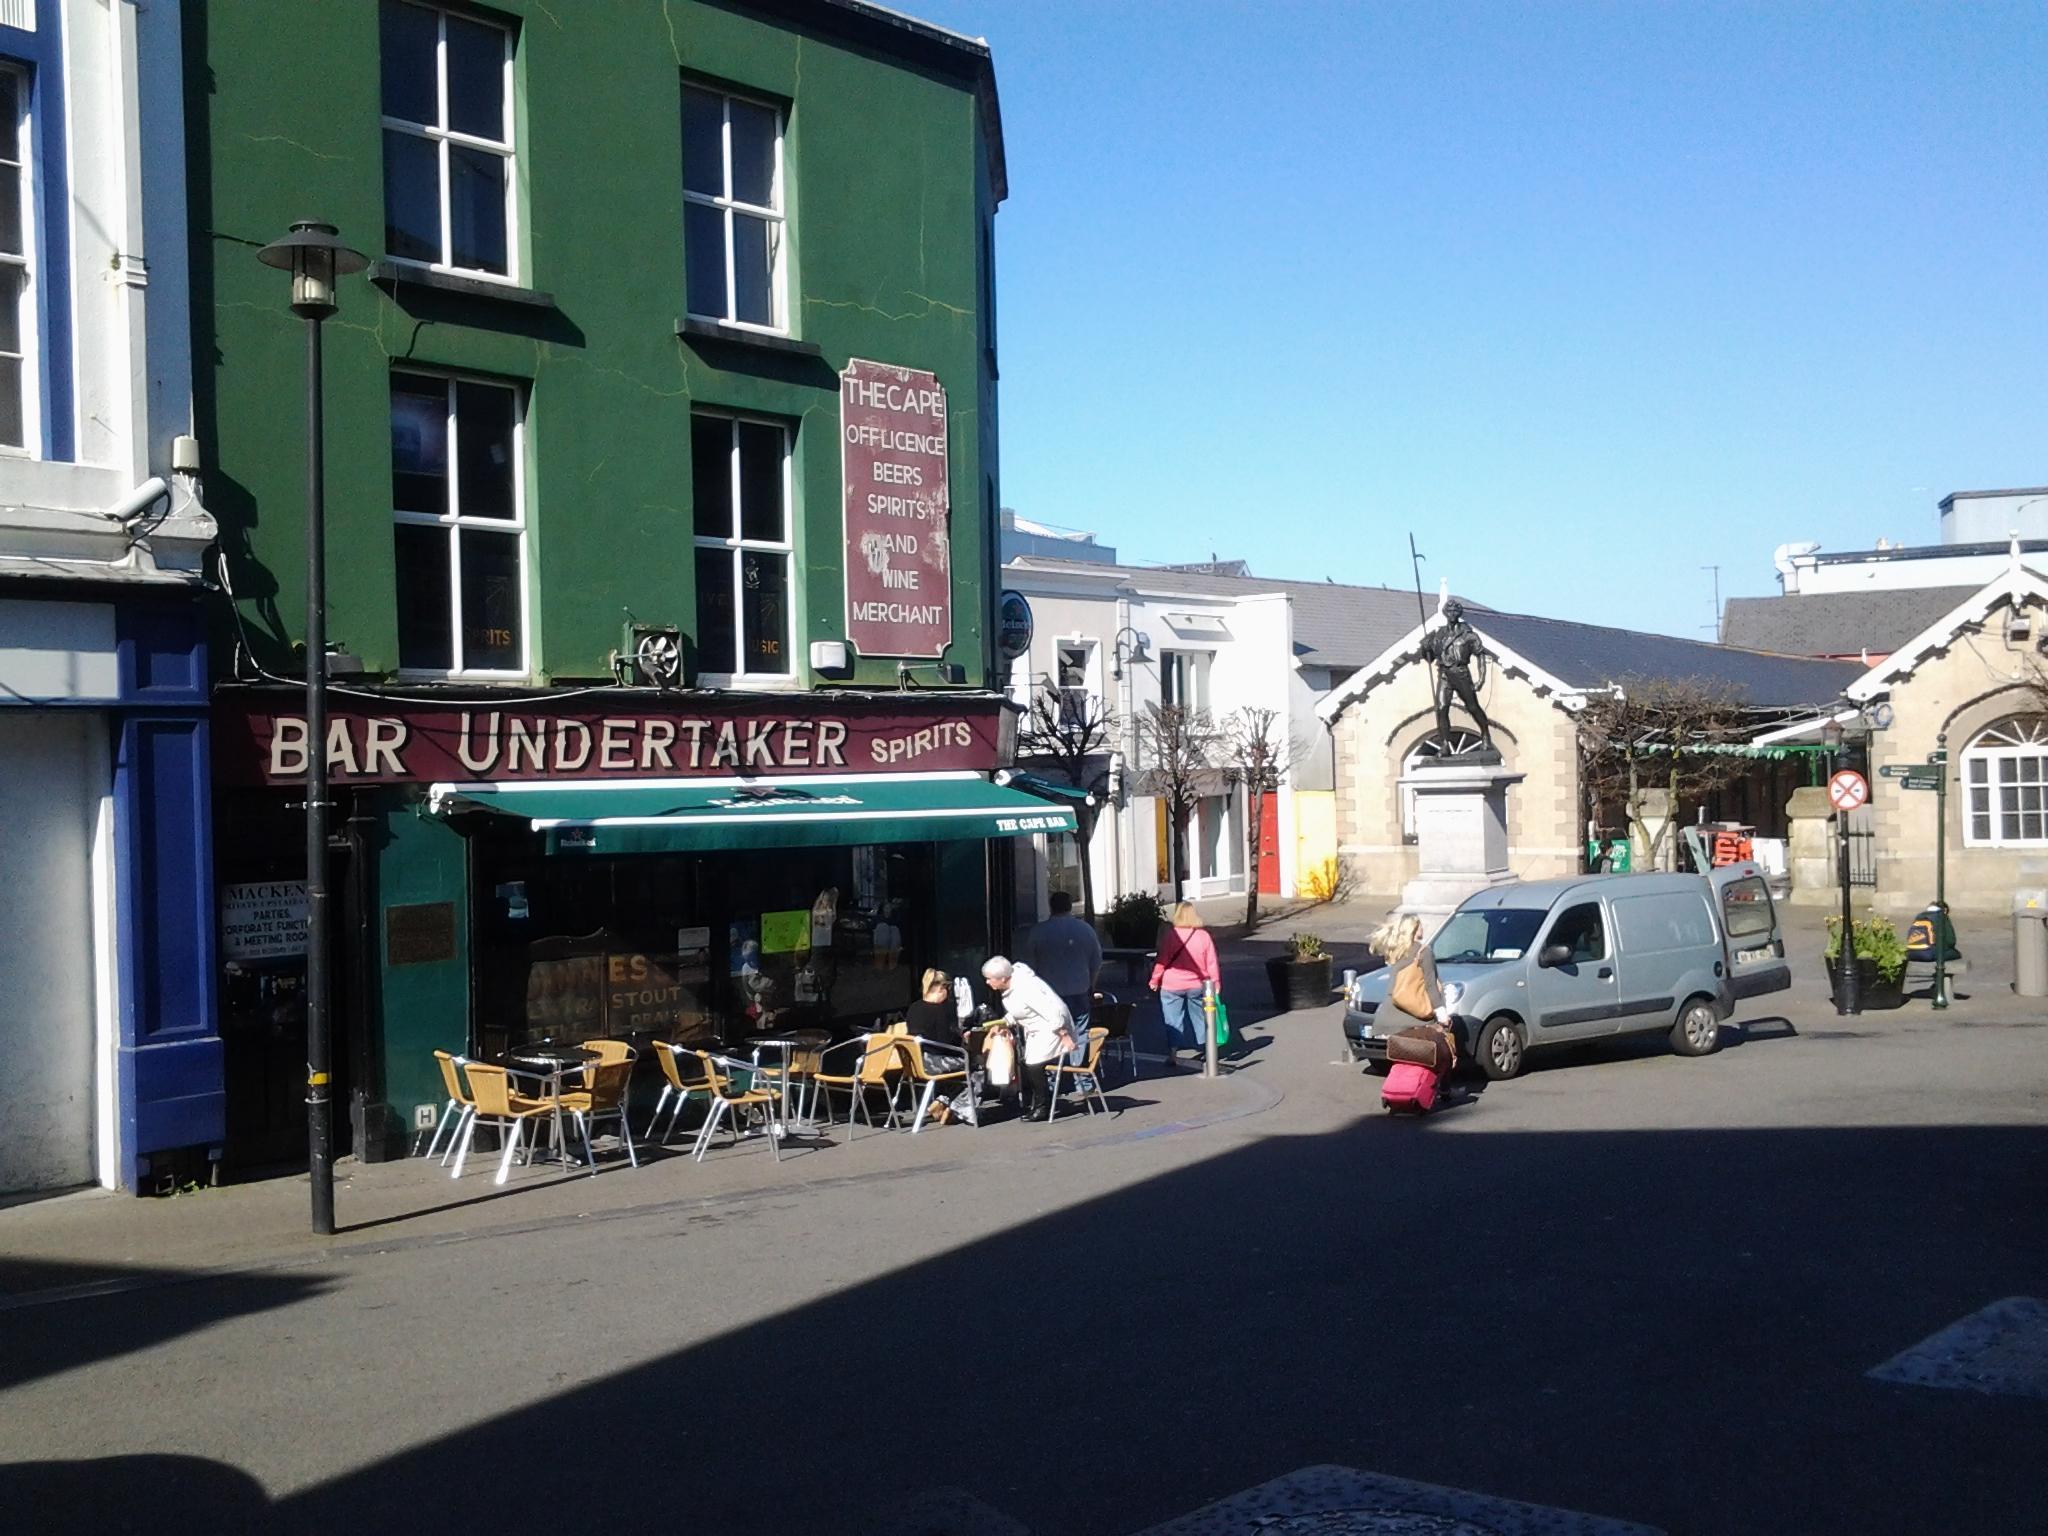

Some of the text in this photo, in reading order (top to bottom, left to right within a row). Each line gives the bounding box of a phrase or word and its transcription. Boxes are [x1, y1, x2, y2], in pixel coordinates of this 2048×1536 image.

[873, 461, 923, 486] BEERS
[867, 493, 926, 520] SPIRITS
[883, 533, 918, 555] AND
[882, 569, 919, 590] WINE
[852, 601, 943, 625] MERCHANT
[270, 711, 972, 774] BAR UNDERTAKER SPIRITS
[995, 819, 1018, 832] THE
[223, 921, 273, 936] ORPORATE
[611, 985, 681, 1009] STOUT
[420, 1108, 432, 1125] H
